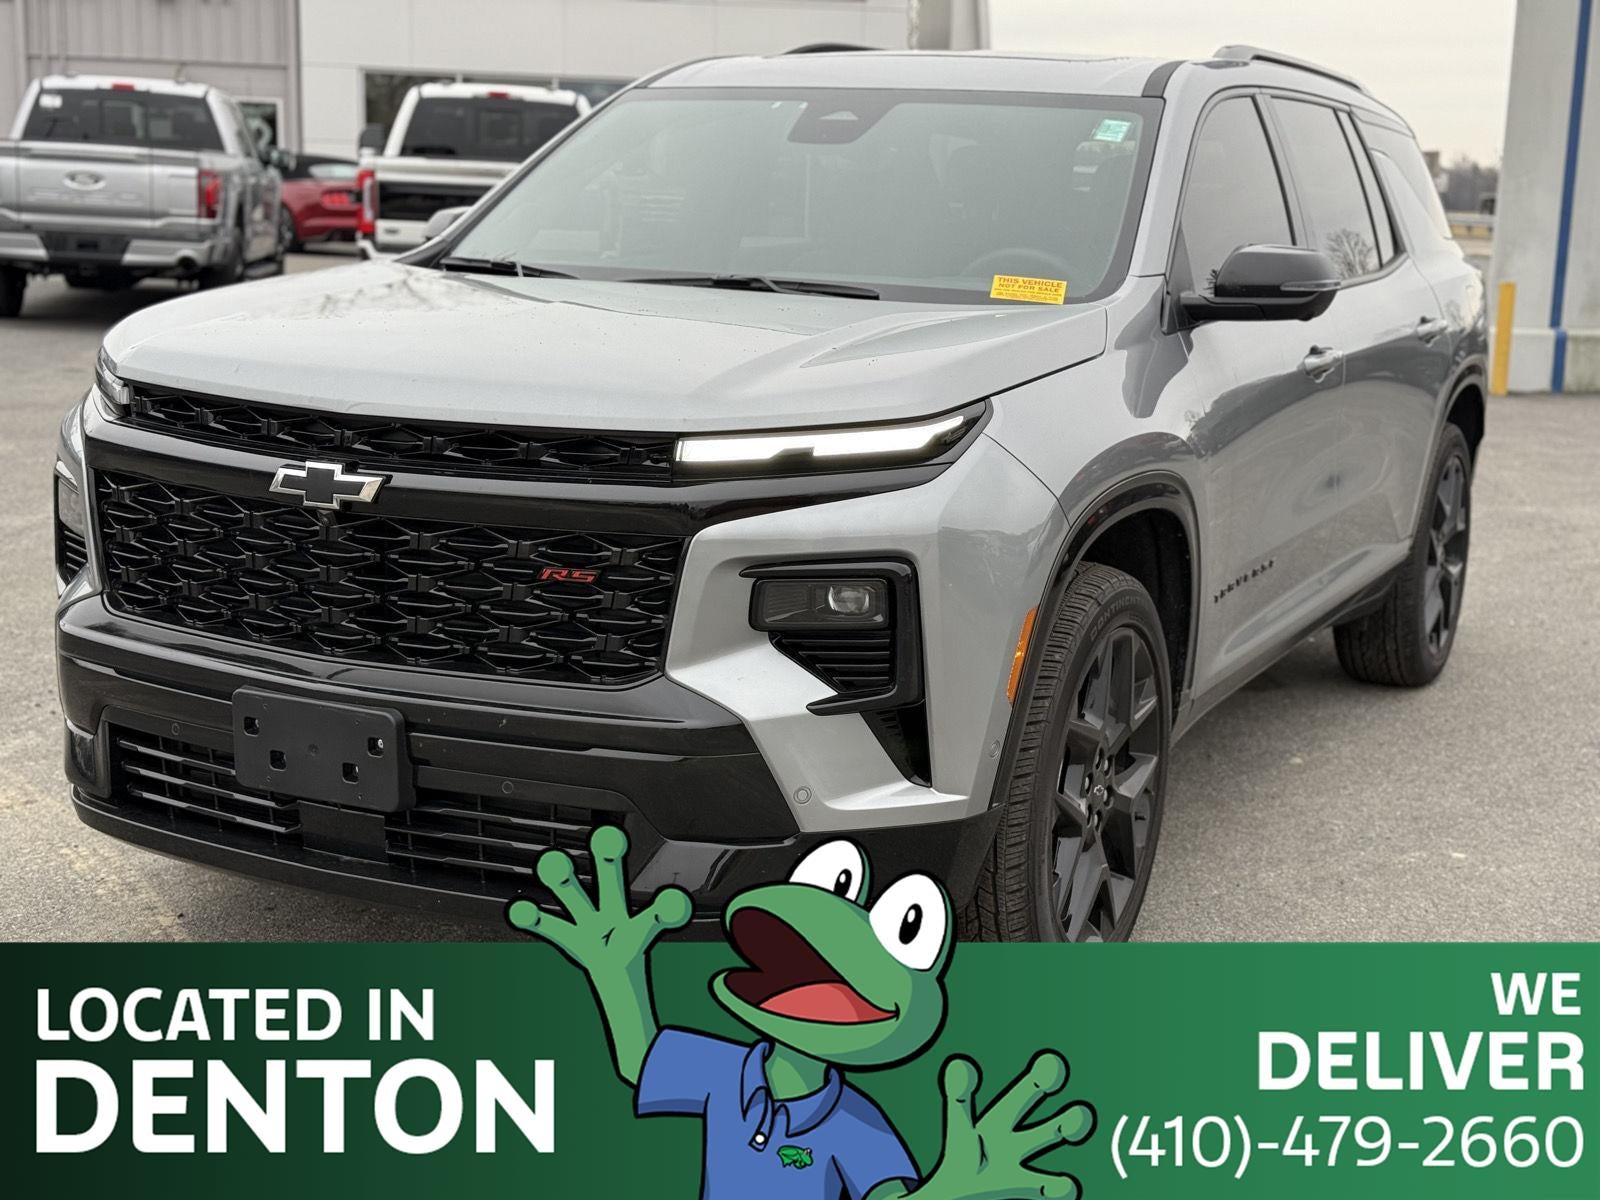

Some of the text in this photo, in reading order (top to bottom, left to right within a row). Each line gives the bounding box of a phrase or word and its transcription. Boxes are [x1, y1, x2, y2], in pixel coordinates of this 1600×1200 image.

[999, 277, 1063, 289] THIS VEHICLE
[540, 567, 597, 583] RS
